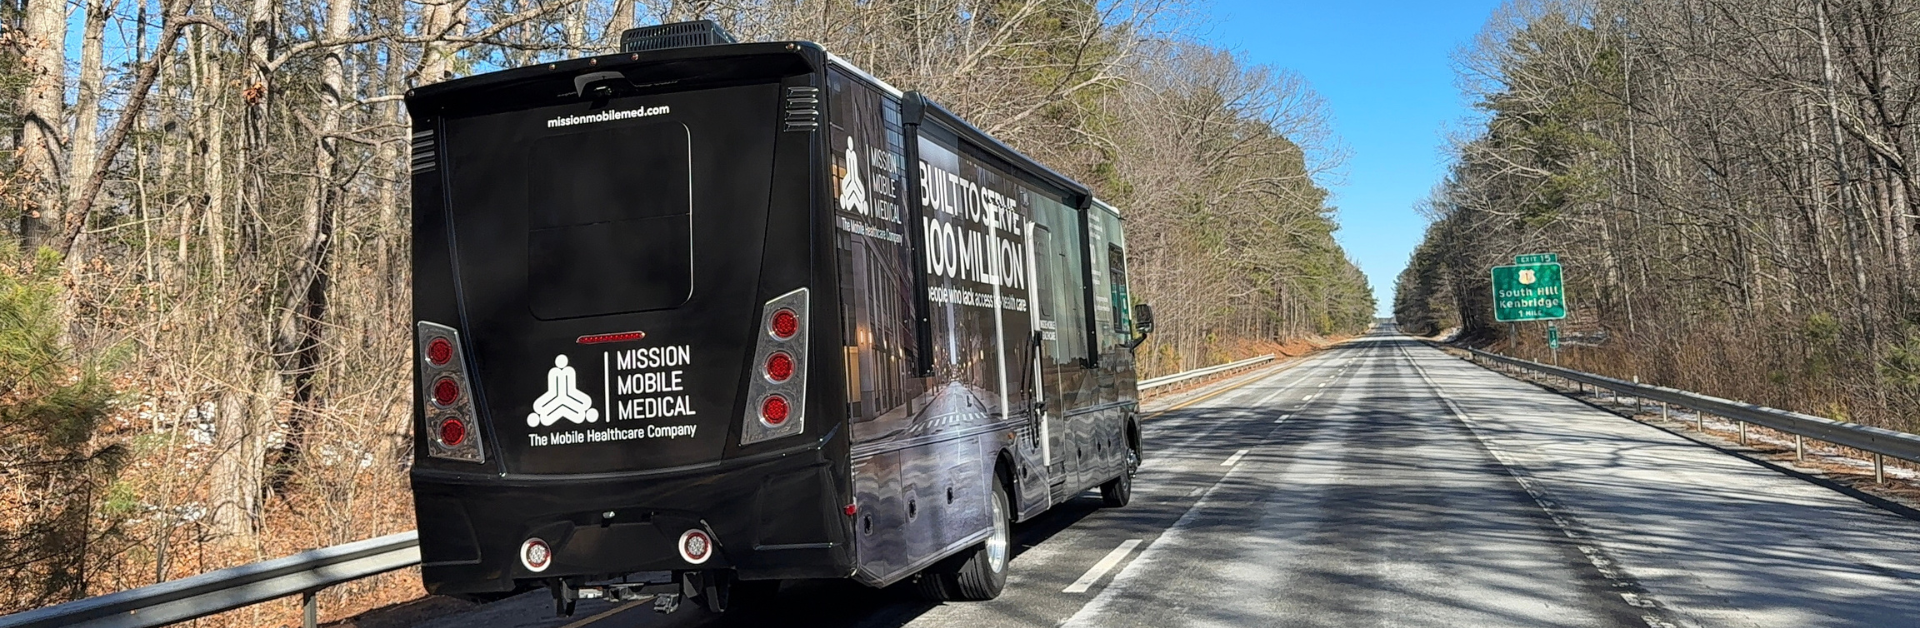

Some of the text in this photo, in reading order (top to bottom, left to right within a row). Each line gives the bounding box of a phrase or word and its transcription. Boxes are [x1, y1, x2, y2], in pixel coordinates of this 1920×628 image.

[547, 106, 670, 128] missionmobilemed.com
[871, 146, 897, 173] MISSION
[873, 172, 897, 198] MOBILE
[919, 160, 1020, 235] BUILT TO SERVE
[874, 198, 902, 224] MEDICAL
[841, 217, 851, 232] The
[851, 219, 865, 235] Mobile
[923, 216, 957, 278] 100
[957, 226, 1024, 290] MILLION
[1540, 254, 1551, 262] 15
[948, 284, 962, 305] who
[962, 286, 975, 306] lack
[975, 292, 993, 308] access
[1016, 298, 1027, 312] care
[1499, 286, 1559, 298] South Hill
[1500, 297, 1559, 309] Kenbridge
[616, 345, 690, 370] MISSION
[617, 370, 683, 395] MOBILE
[618, 395, 696, 420] MEDICAL
[528, 424, 697, 447] The Mobile Healthcare Company
